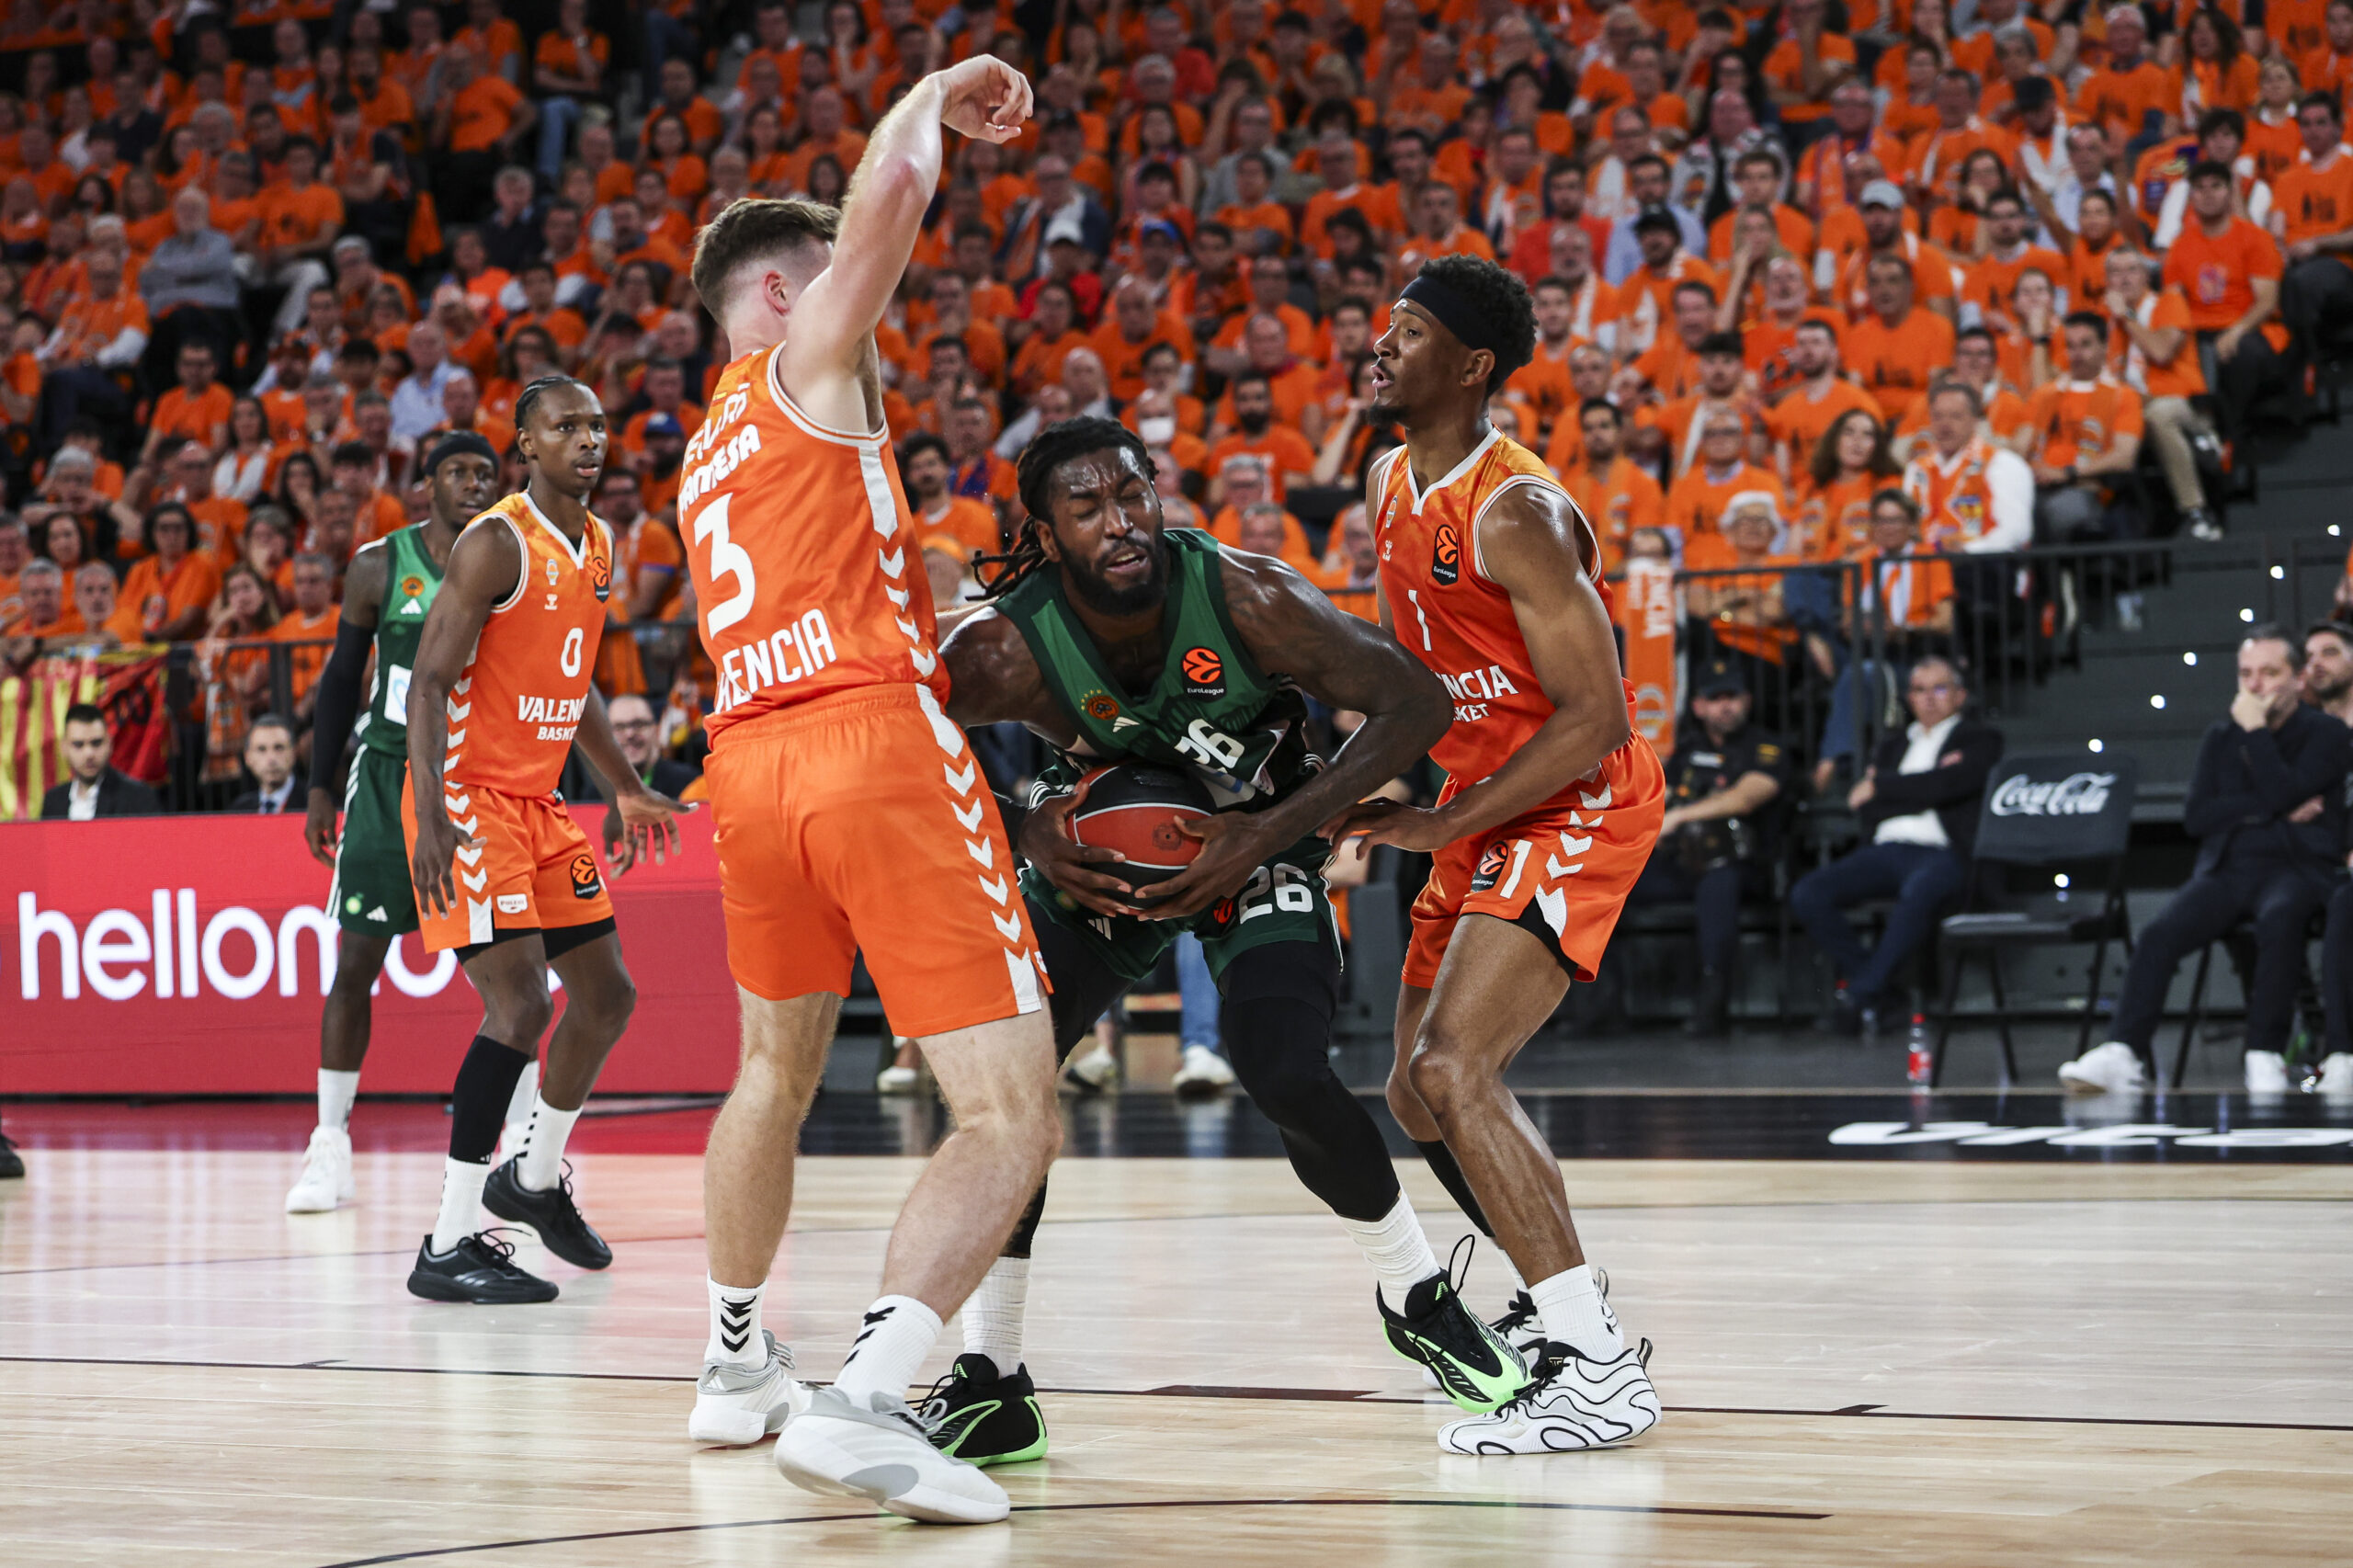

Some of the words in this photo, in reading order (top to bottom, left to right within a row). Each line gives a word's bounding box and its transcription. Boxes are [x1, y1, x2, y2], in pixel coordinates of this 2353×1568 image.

[693, 492, 756, 641] 3
[1407, 589, 1432, 652] 1
[560, 627, 584, 677] 0
[1435, 665, 1519, 699] NCIA
[1187, 687, 1224, 696] EuroLeague
[1238, 862, 1313, 925] 26
[1499, 838, 1534, 900] 1
